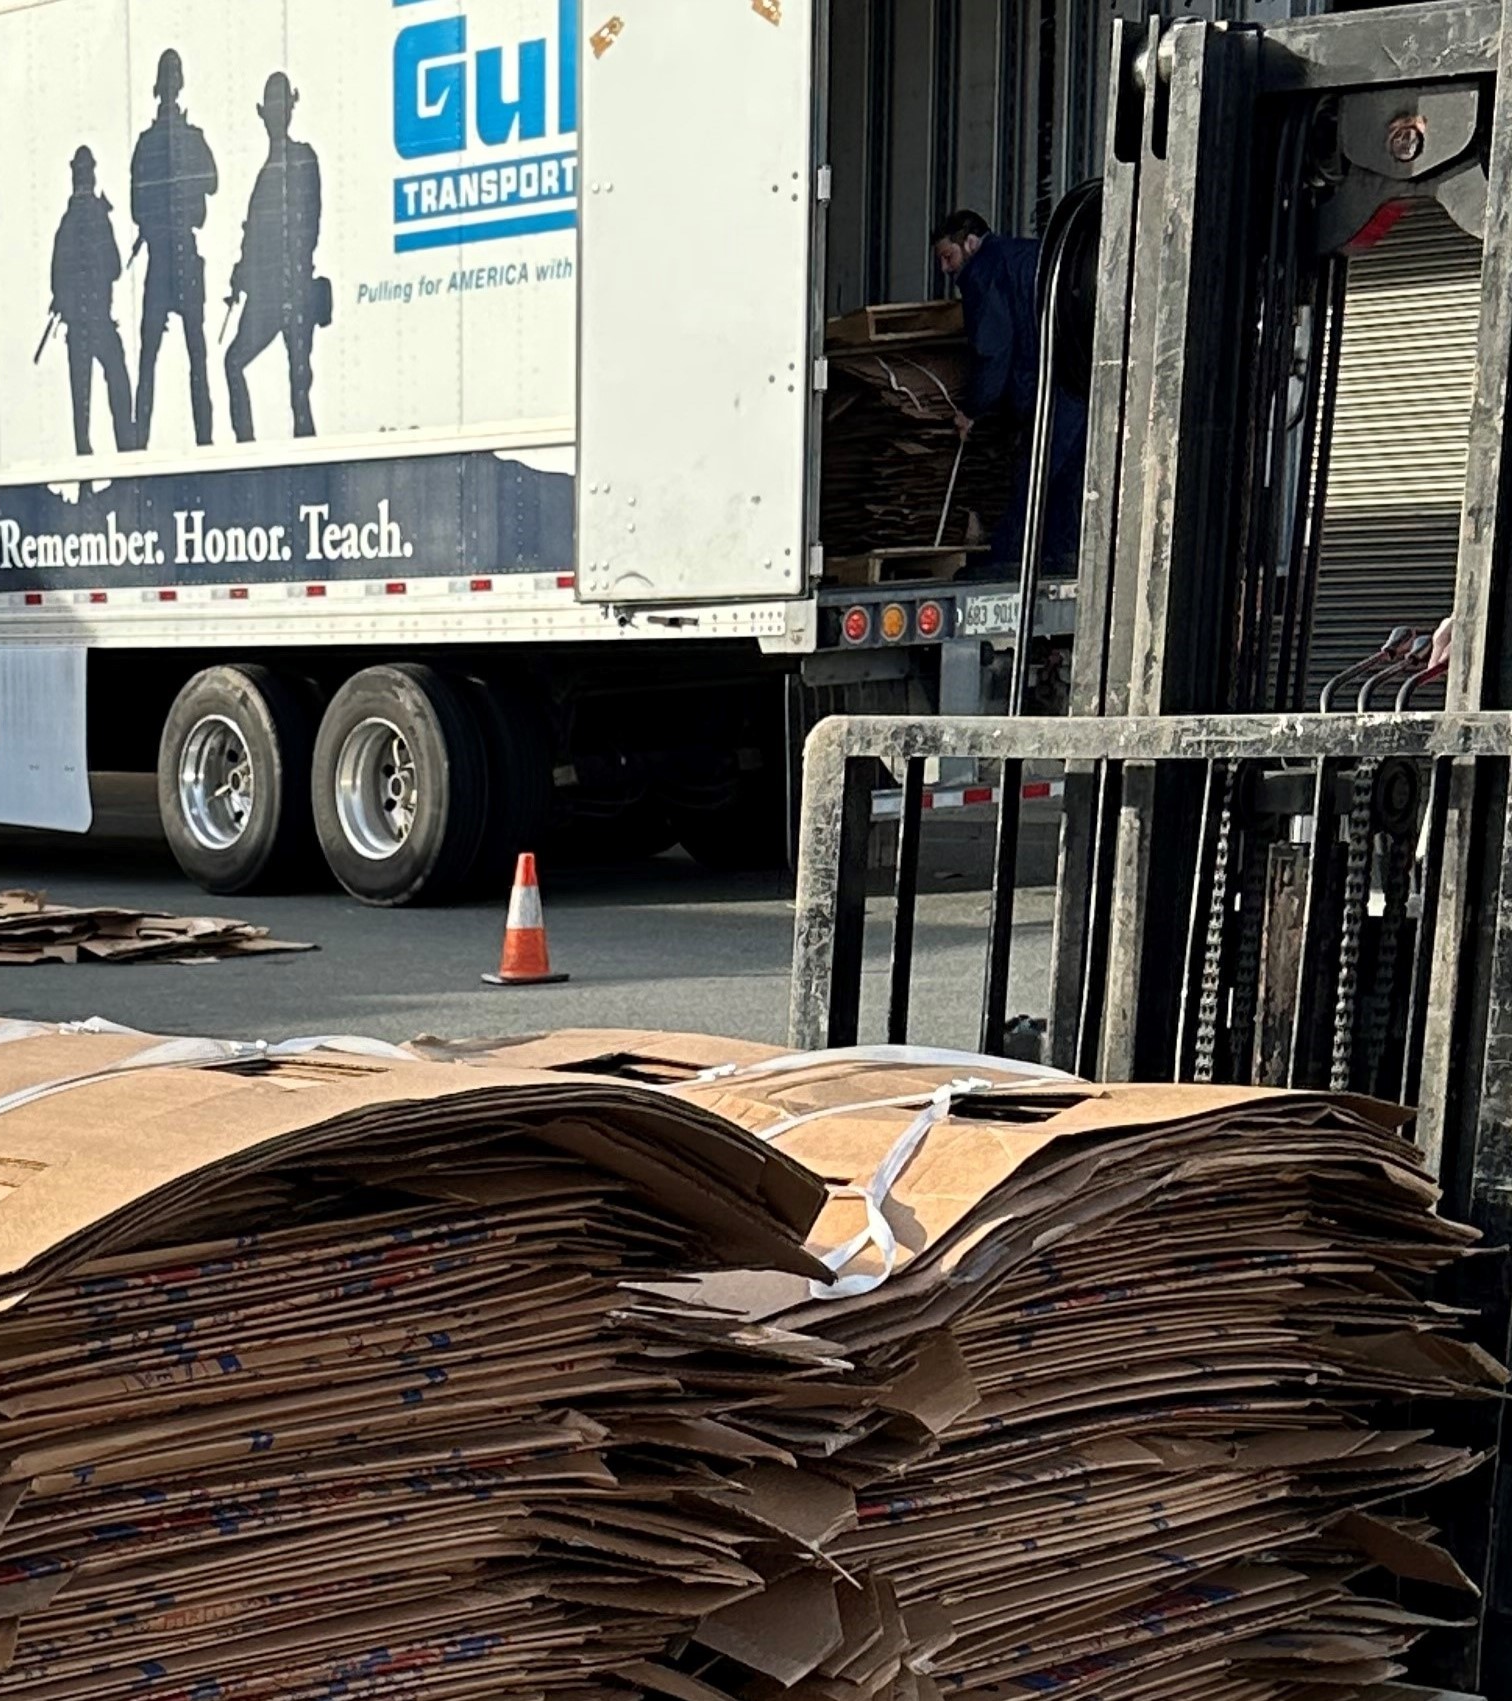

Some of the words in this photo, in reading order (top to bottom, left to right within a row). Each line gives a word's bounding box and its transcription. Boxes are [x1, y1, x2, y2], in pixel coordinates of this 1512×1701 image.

[357, 282, 413, 304] Pulling
[418, 273, 442, 297] for
[446, 262, 529, 293] AMERICA
[535, 257, 572, 281] with
[173, 510, 292, 564] Honor.
[299, 499, 414, 560] Teach.
